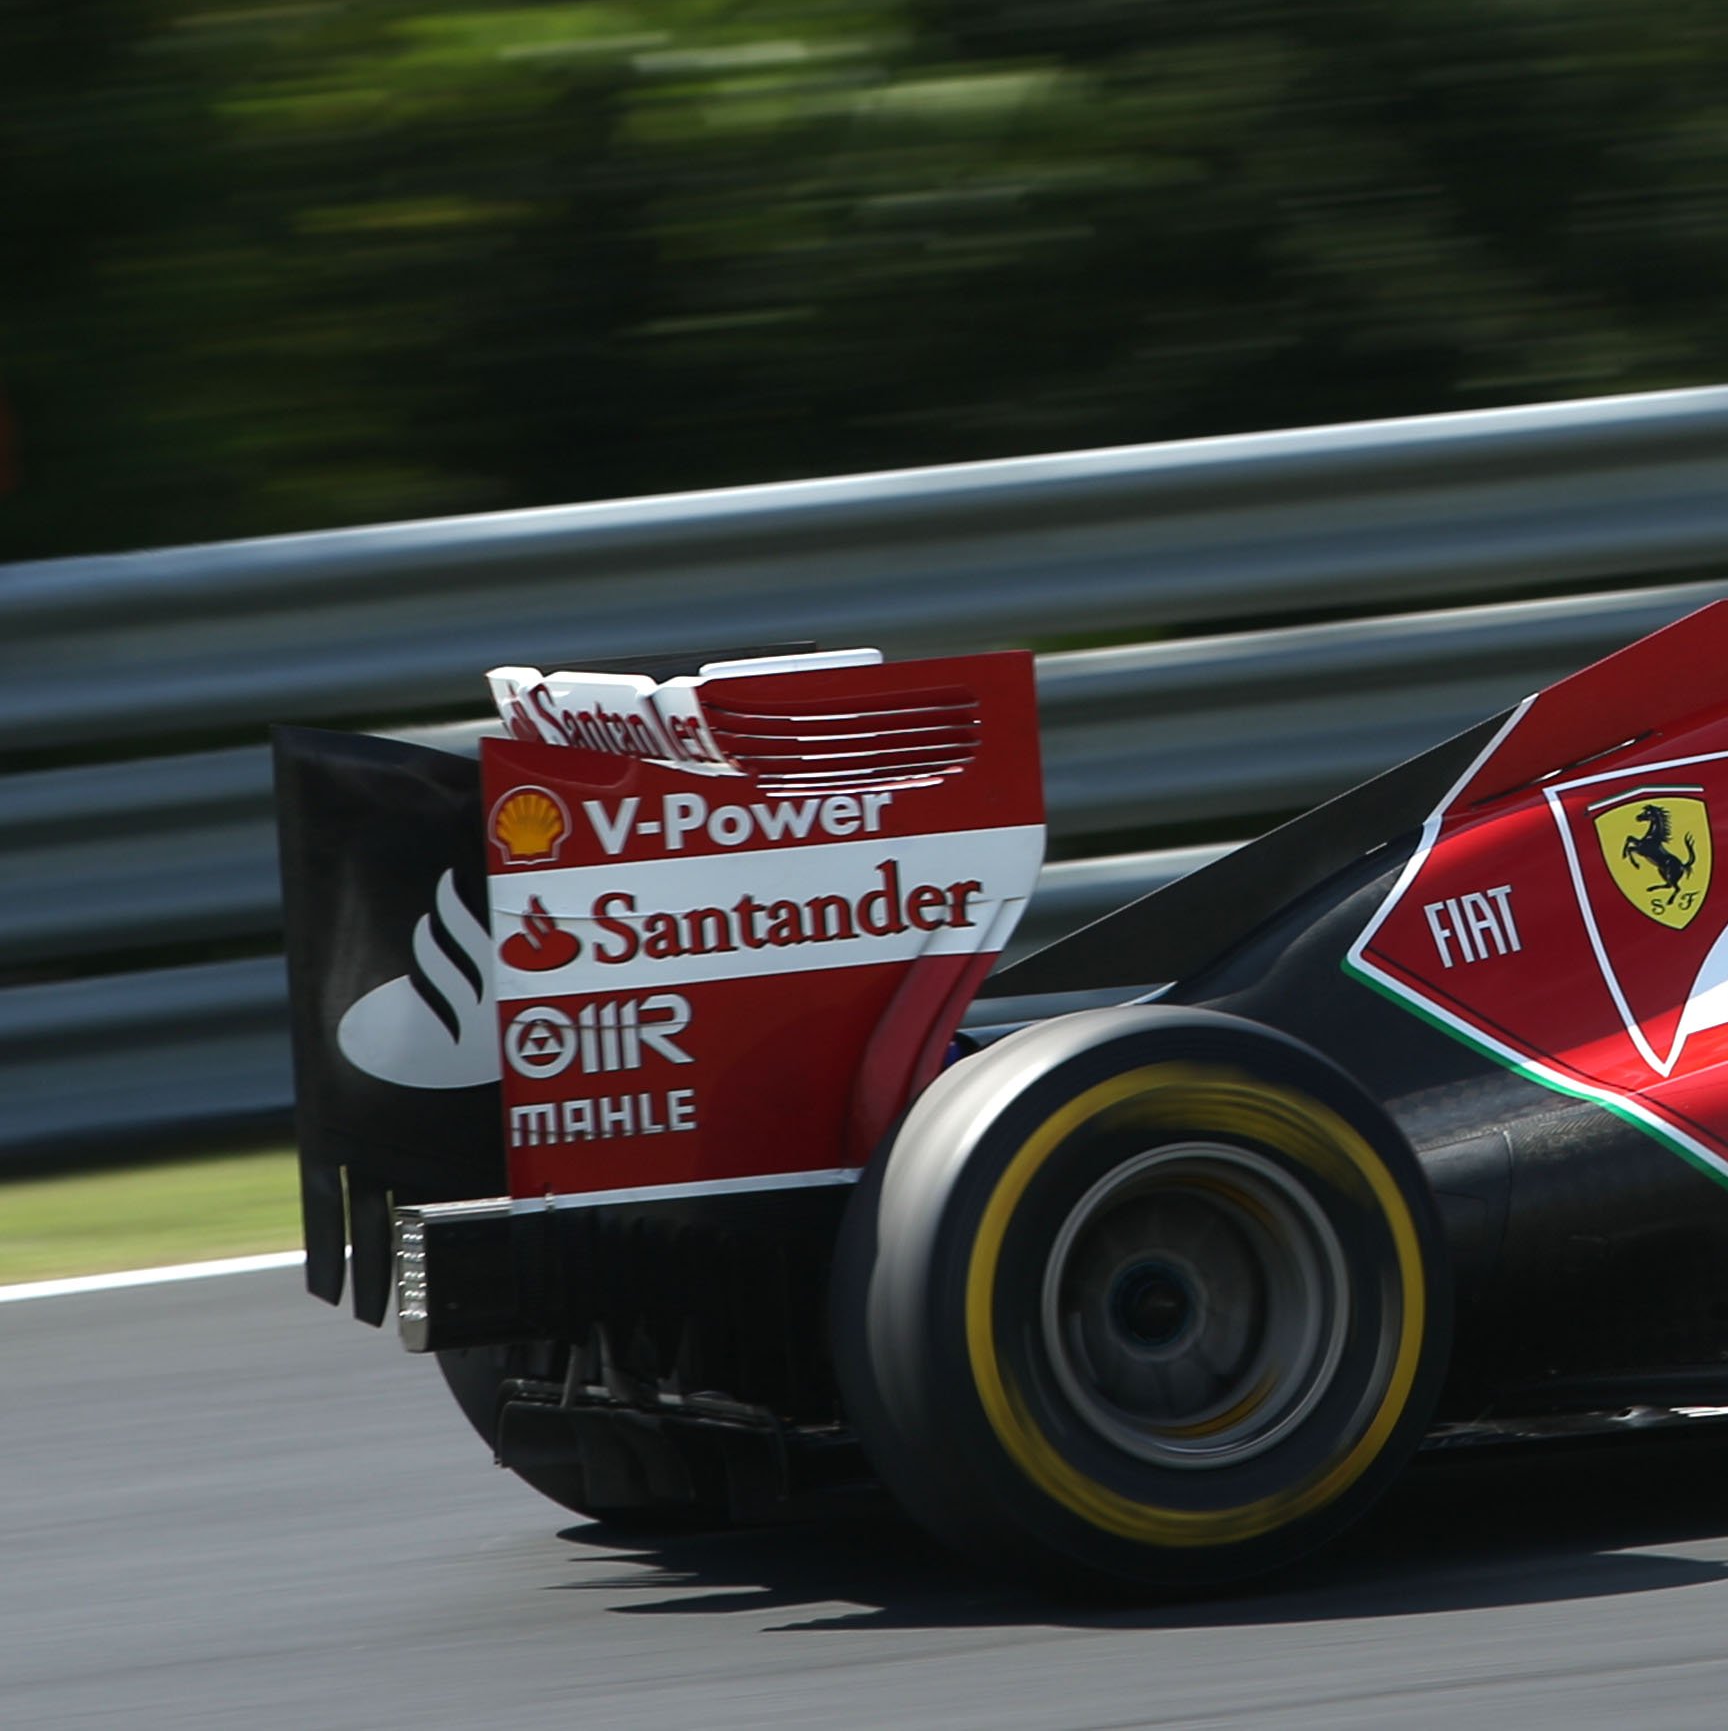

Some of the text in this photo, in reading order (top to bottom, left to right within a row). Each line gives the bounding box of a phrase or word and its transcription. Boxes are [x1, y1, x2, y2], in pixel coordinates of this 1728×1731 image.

[583, 791, 894, 856] V-Power
[592, 860, 982, 964] Santander
[1424, 885, 1522, 968] FIAT
[510, 1088, 697, 1148] MAHLE
